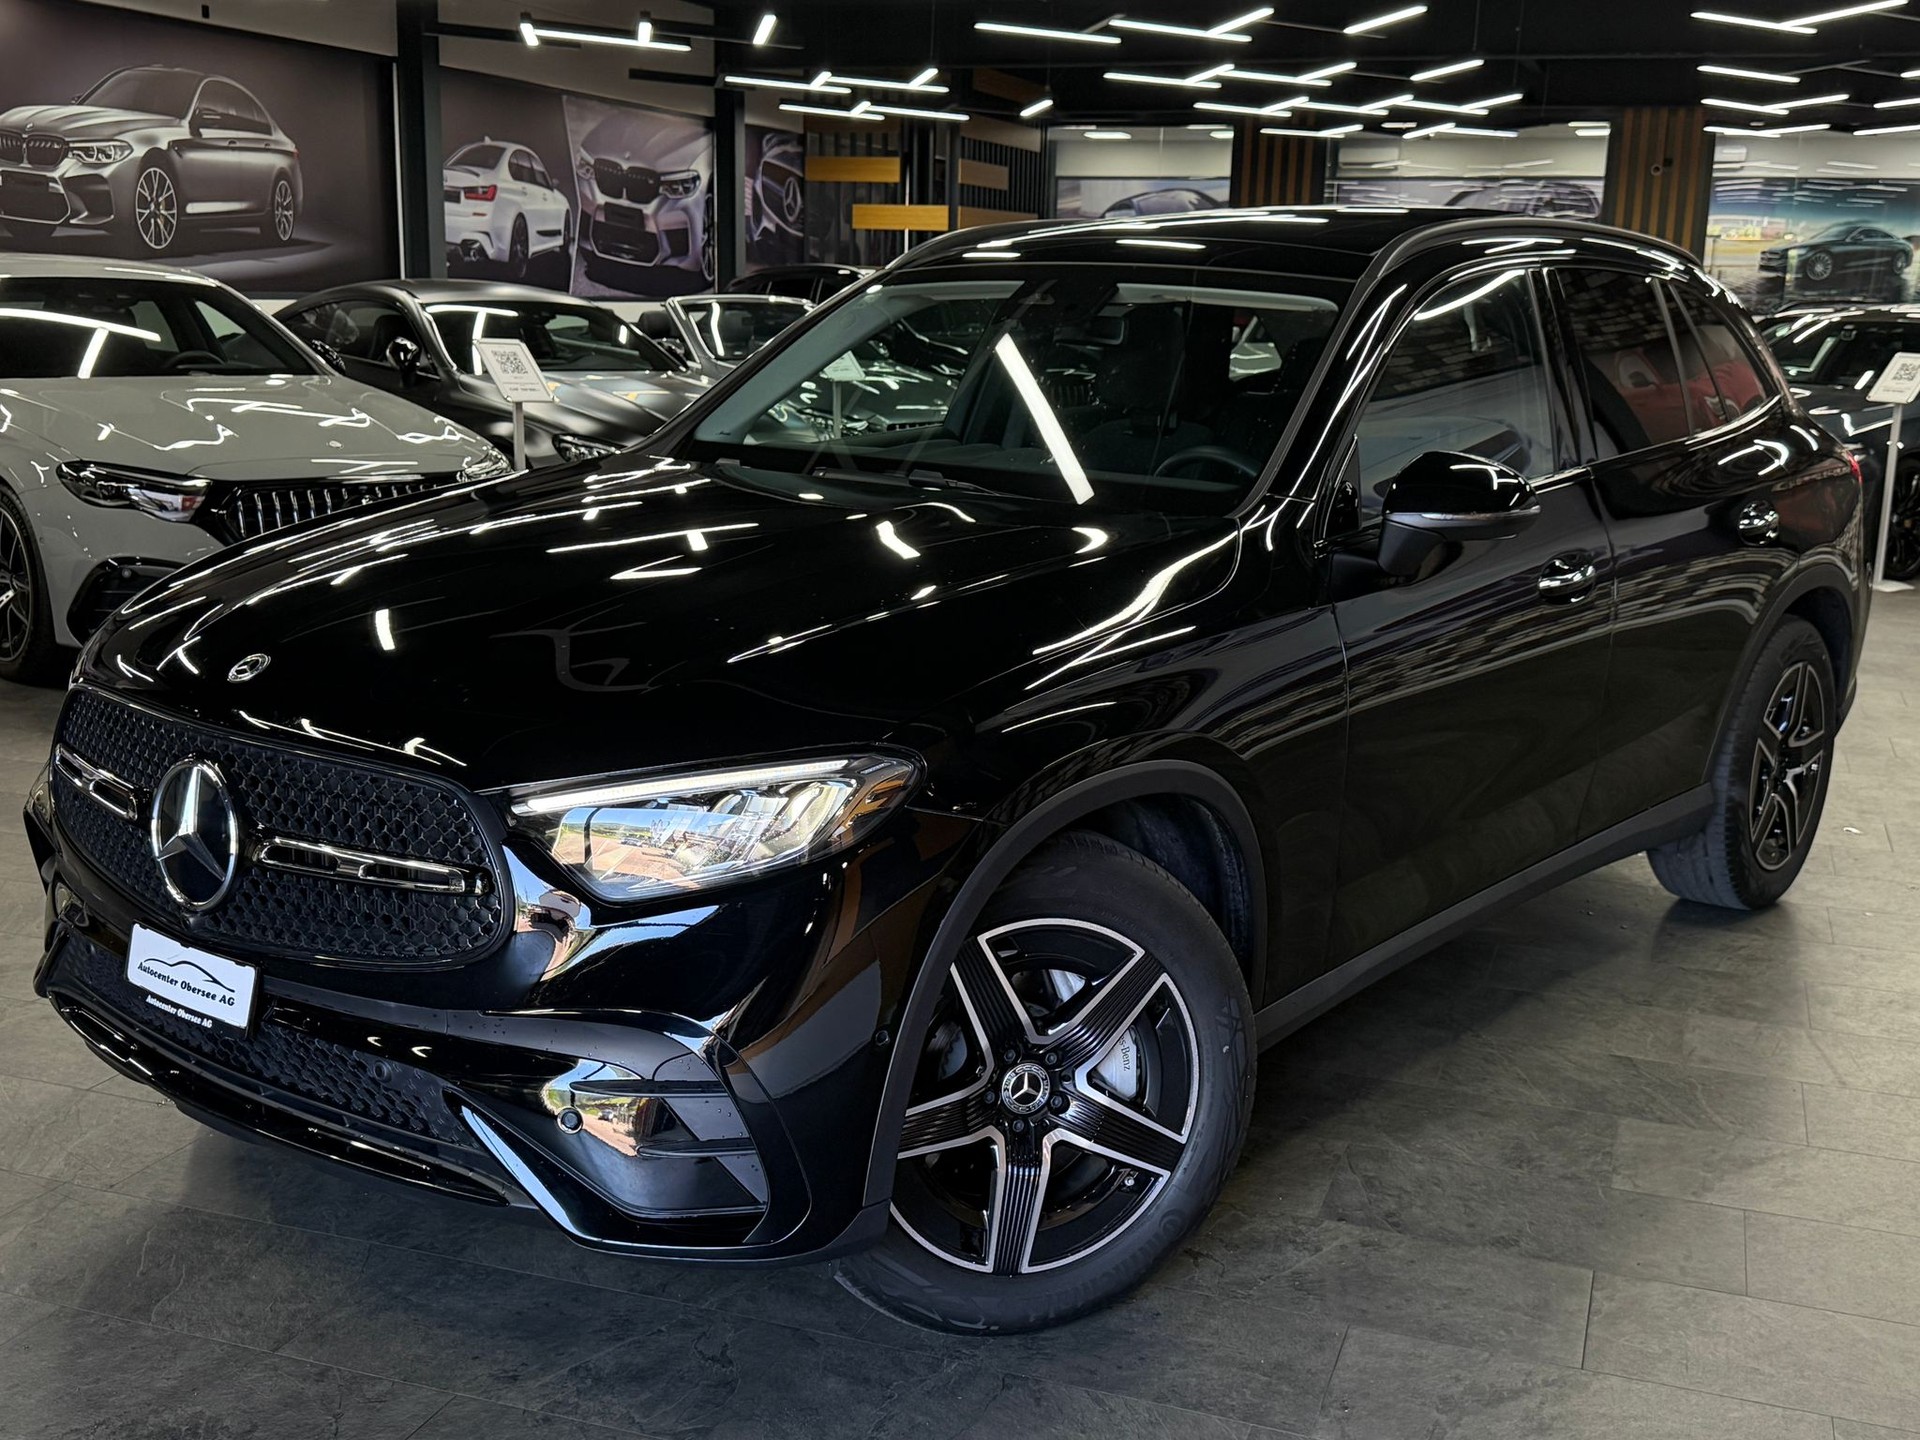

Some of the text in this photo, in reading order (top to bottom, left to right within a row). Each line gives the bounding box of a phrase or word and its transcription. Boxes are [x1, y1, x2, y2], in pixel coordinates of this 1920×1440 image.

[137, 962, 235, 1006] Autocenter Obersee AG
[145, 995, 213, 1028] Autocenter Obersee AG
